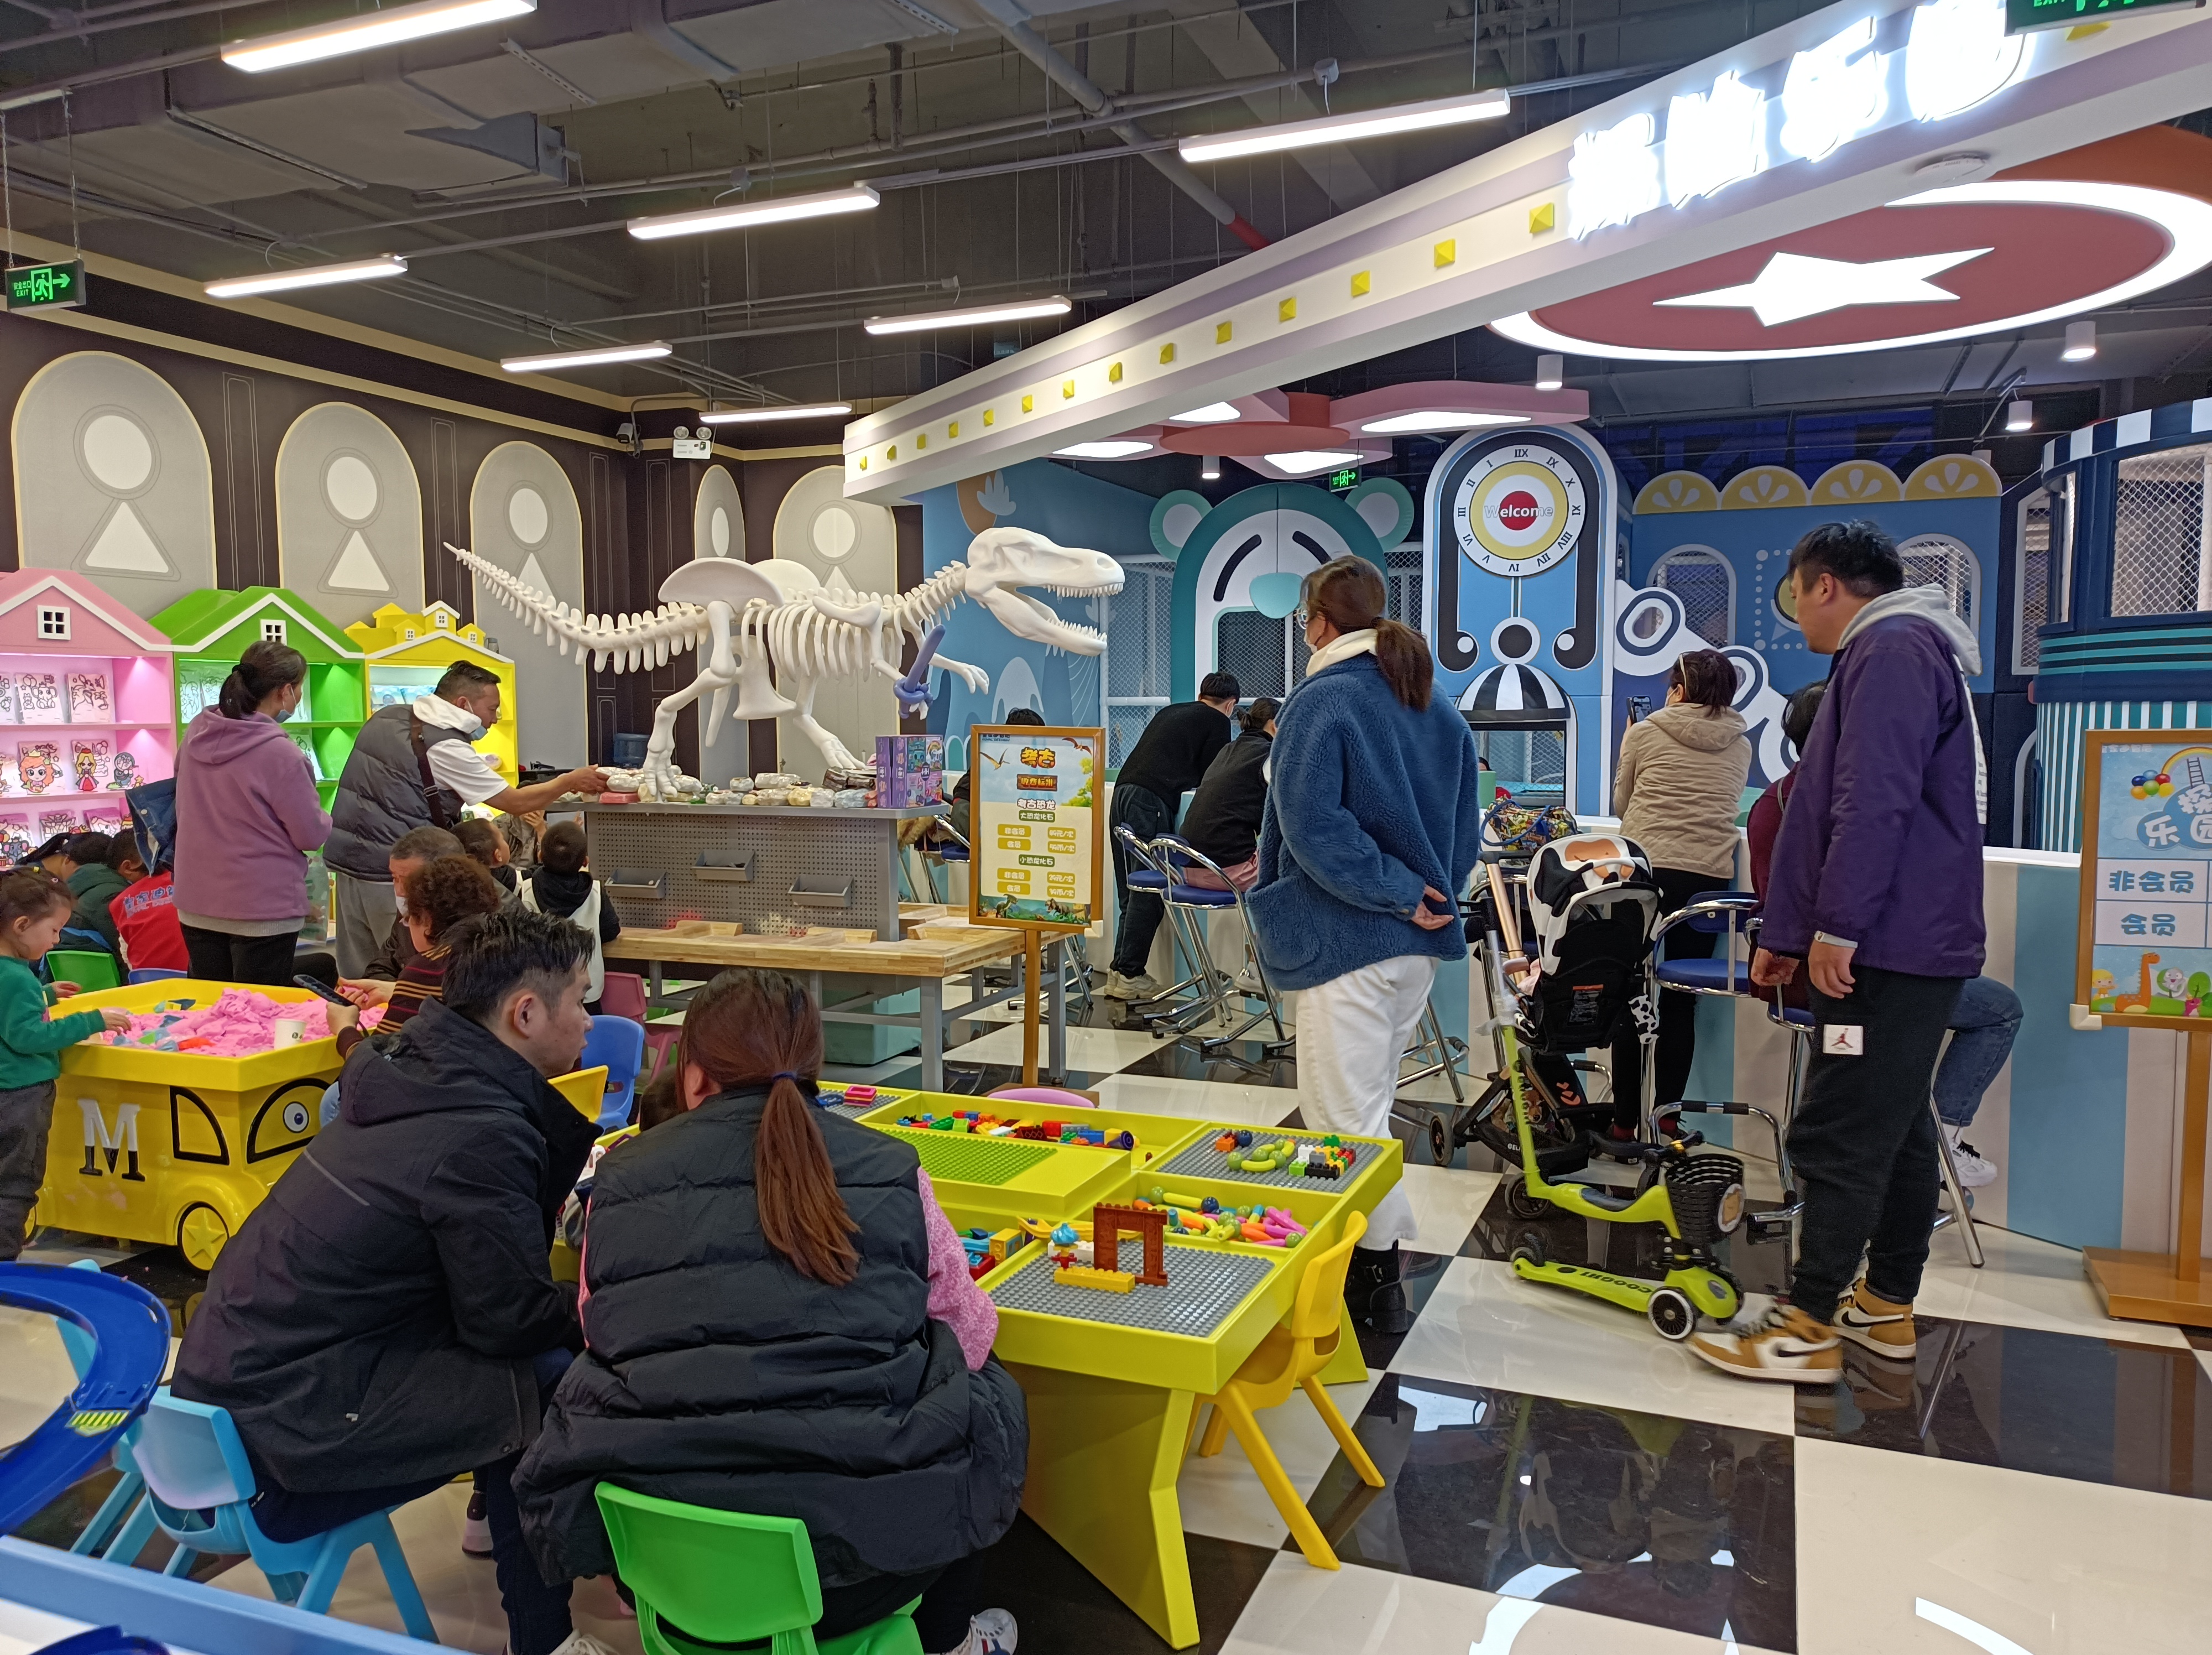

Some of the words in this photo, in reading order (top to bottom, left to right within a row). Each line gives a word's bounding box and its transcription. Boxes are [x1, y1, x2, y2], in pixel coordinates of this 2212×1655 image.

[1484, 504, 1553, 518] Welcome
[1020, 747, 1055, 768] 考古
[1017, 798, 1056, 810] 考古恐龙
[1020, 812, 1053, 821] 大恐龙化石
[1020, 856, 1053, 865] 小恐龙化石
[2109, 870, 2194, 893] 非会员
[2121, 913, 2176, 936] 会员
[77, 1097, 146, 1182] M
